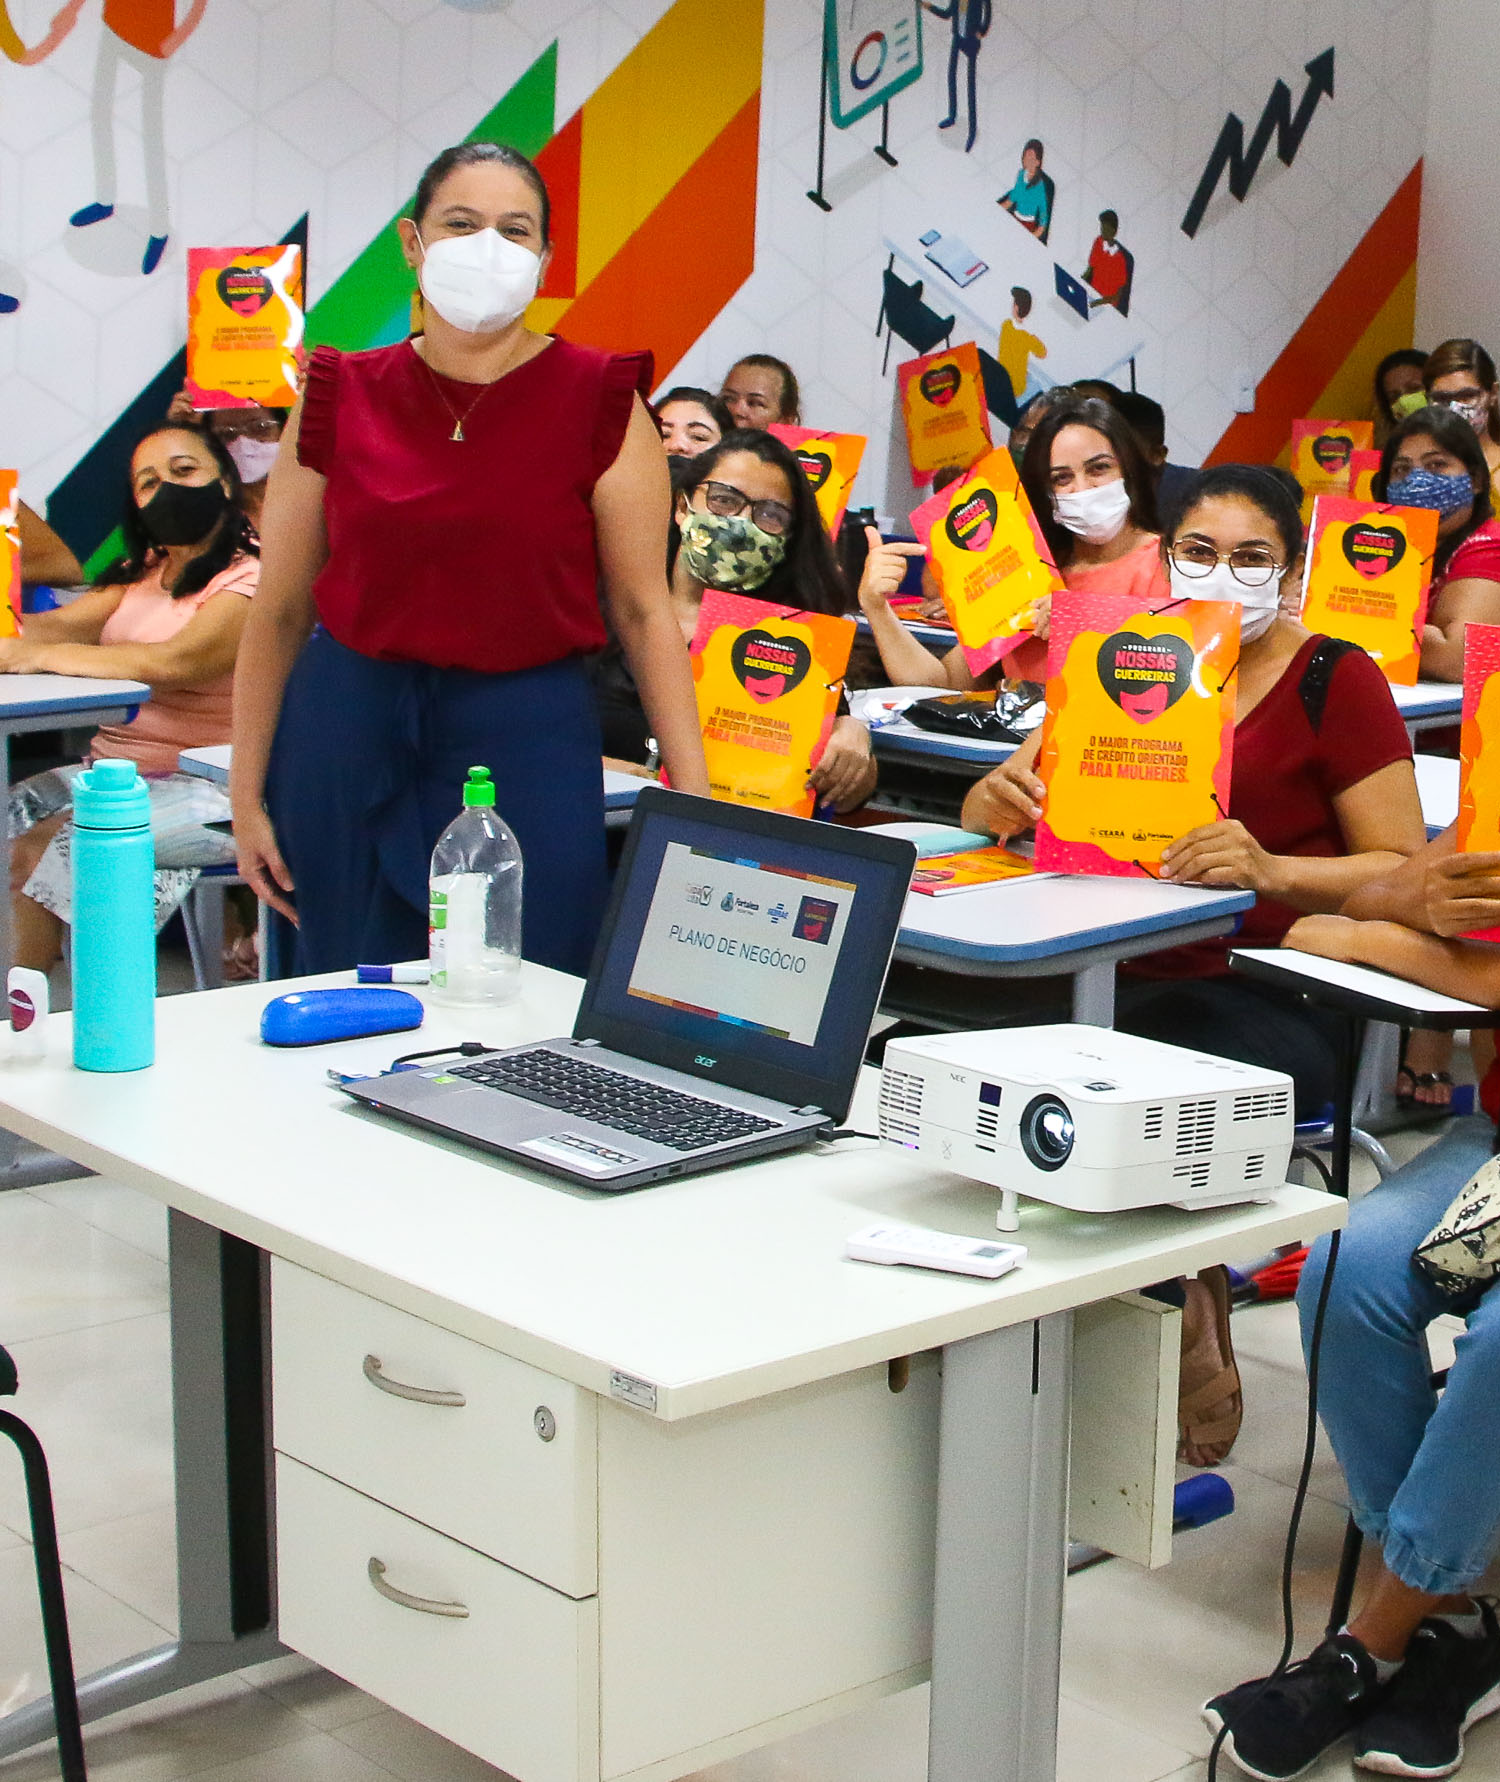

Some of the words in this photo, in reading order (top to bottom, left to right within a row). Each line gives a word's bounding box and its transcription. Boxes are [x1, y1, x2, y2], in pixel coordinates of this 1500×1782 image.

[746, 643, 797, 666] NOSSAS
[1115, 651, 1177, 670] NOSSAS
[1115, 669, 1176, 682] GUERREIRAS
[1090, 736, 1096, 747] O
[1098, 736, 1128, 749] MAIOR
[1131, 739, 1182, 751] PROGRAMA
[1084, 749, 1095, 761] DE
[1097, 748, 1135, 764] CRÉDITO
[1138, 753, 1188, 766] ORIENTADO
[1080, 761, 1112, 778] PARA
[669, 924, 715, 950] PLANO
[717, 937, 736, 956] DE
[739, 943, 806, 974] NEGÓCIO
[694, 1054, 717, 1068] acer
[950, 1072, 966, 1084] NEC
